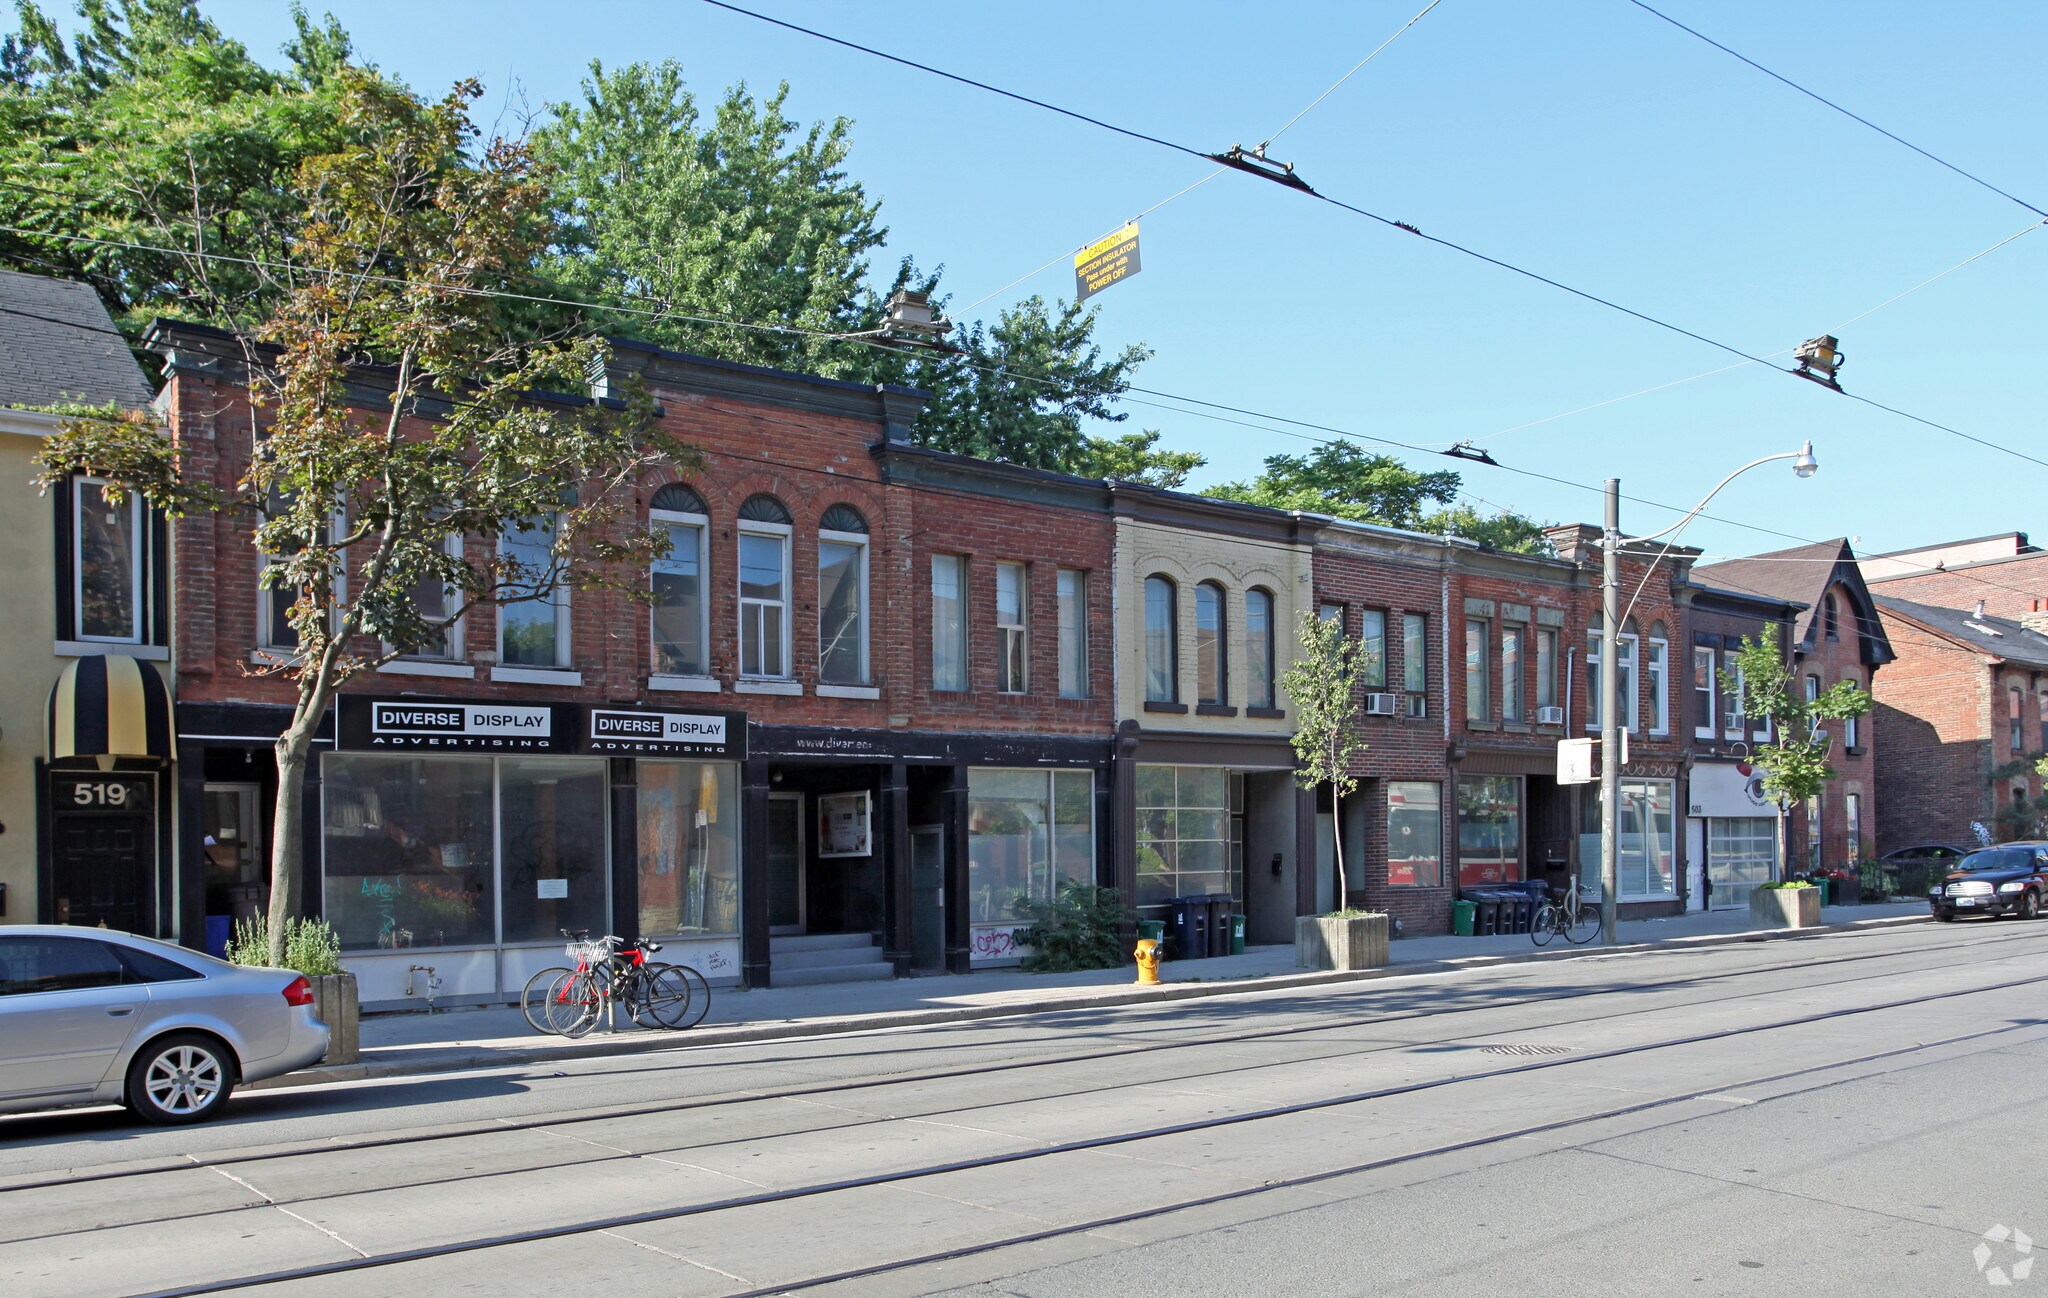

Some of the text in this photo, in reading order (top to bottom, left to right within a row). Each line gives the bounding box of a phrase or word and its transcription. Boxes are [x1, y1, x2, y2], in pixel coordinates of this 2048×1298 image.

[1088, 233, 1121, 257] CAUTION
[1078, 241, 1136, 277] SECTION INSULATOR
[1086, 257, 1128, 283] Pass under with
[1088, 266, 1126, 292] POWER OFF
[382, 711, 544, 728] DIVERSE DISPLAY
[599, 719, 721, 735] DIVERSE DISPLAY
[372, 737, 550, 747] ADVERTISING
[591, 742, 725, 753] ADVERTISING
[74, 783, 126, 805] 519
